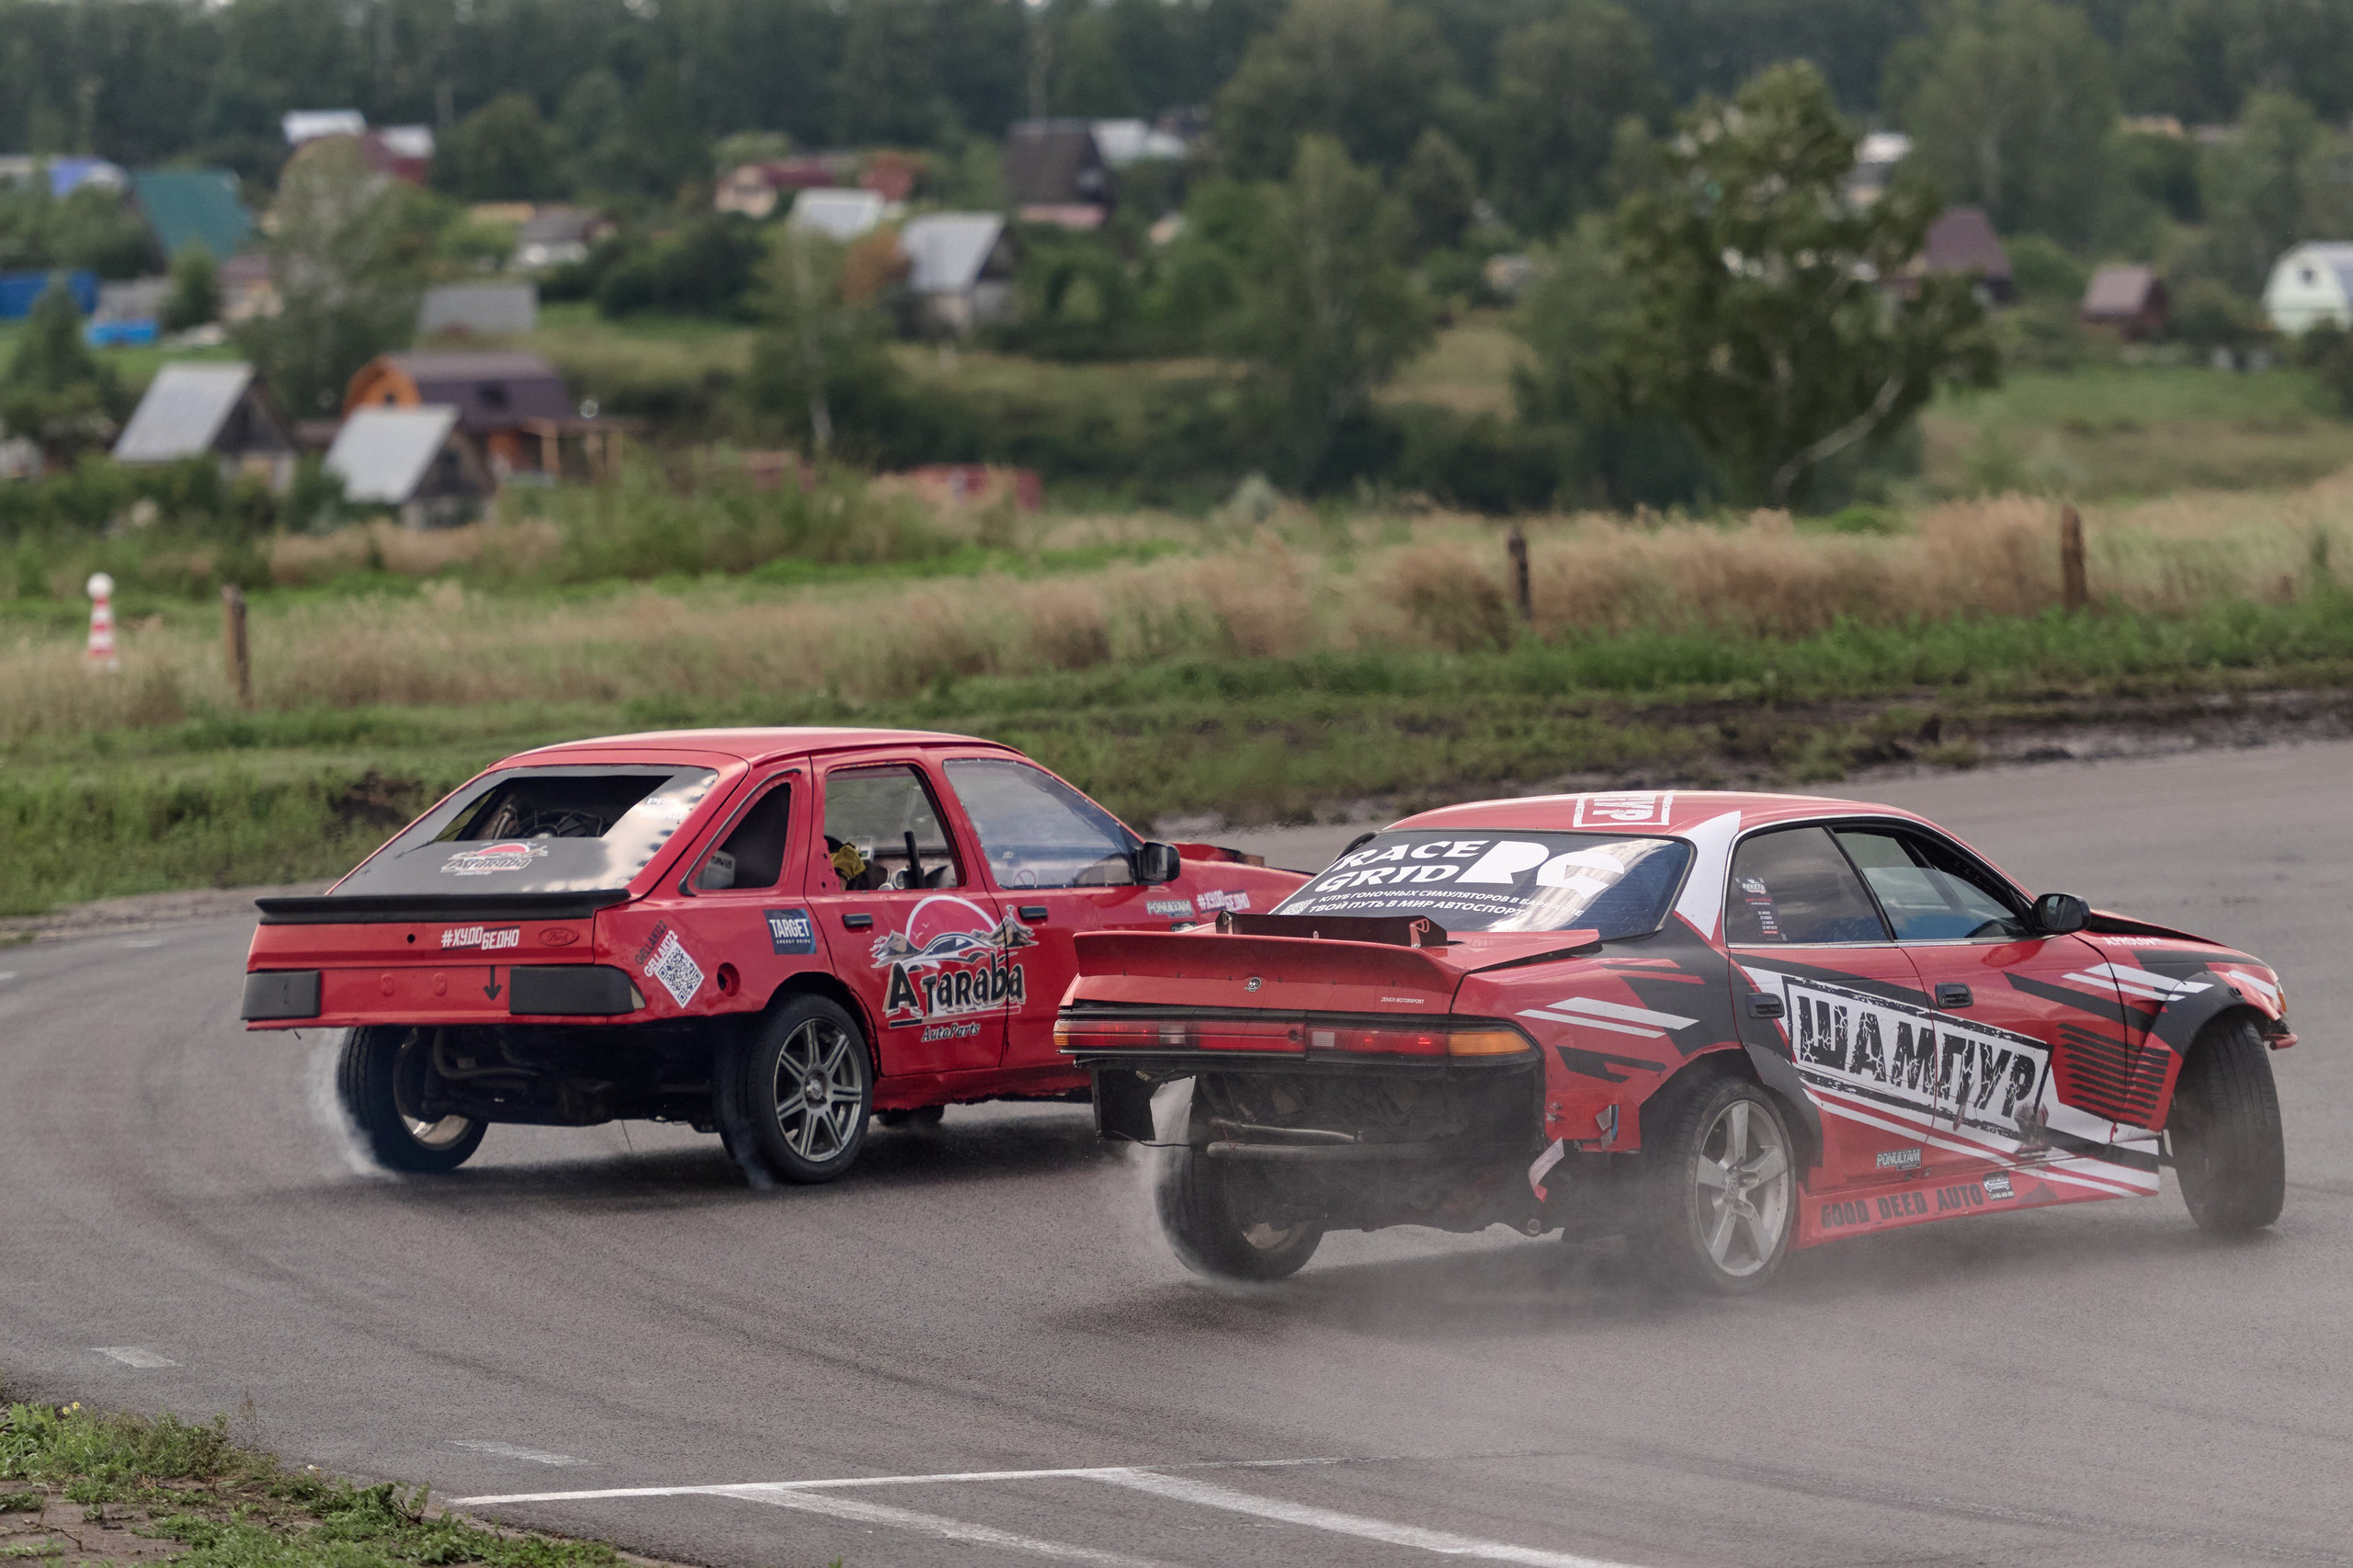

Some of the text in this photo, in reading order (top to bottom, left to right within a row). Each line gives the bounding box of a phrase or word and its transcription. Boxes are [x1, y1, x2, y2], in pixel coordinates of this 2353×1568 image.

[1331, 840, 1490, 873] RACE
[1315, 864, 1460, 892] GRID
[1309, 900, 1533, 917] ТВОЙ ПУТЬ В МИР АВТОСПОРТА
[1319, 892, 1350, 903] КЛУБ
[1350, 890, 1420, 899] ГОНОЧНЫХ
[1420, 890, 1510, 903] СИМУЛЯТОРОВ
[441, 926, 520, 950] #ХУДОБЕДНО
[768, 919, 810, 937] TARGET
[635, 920, 668, 965] GELLAKI22
[643, 929, 678, 977] GELLAKI22
[921, 1022, 981, 1042] AutoParts
[1798, 995, 2036, 1119] ШАМПУР
[1877, 1150, 1920, 1167] PONULYAM
